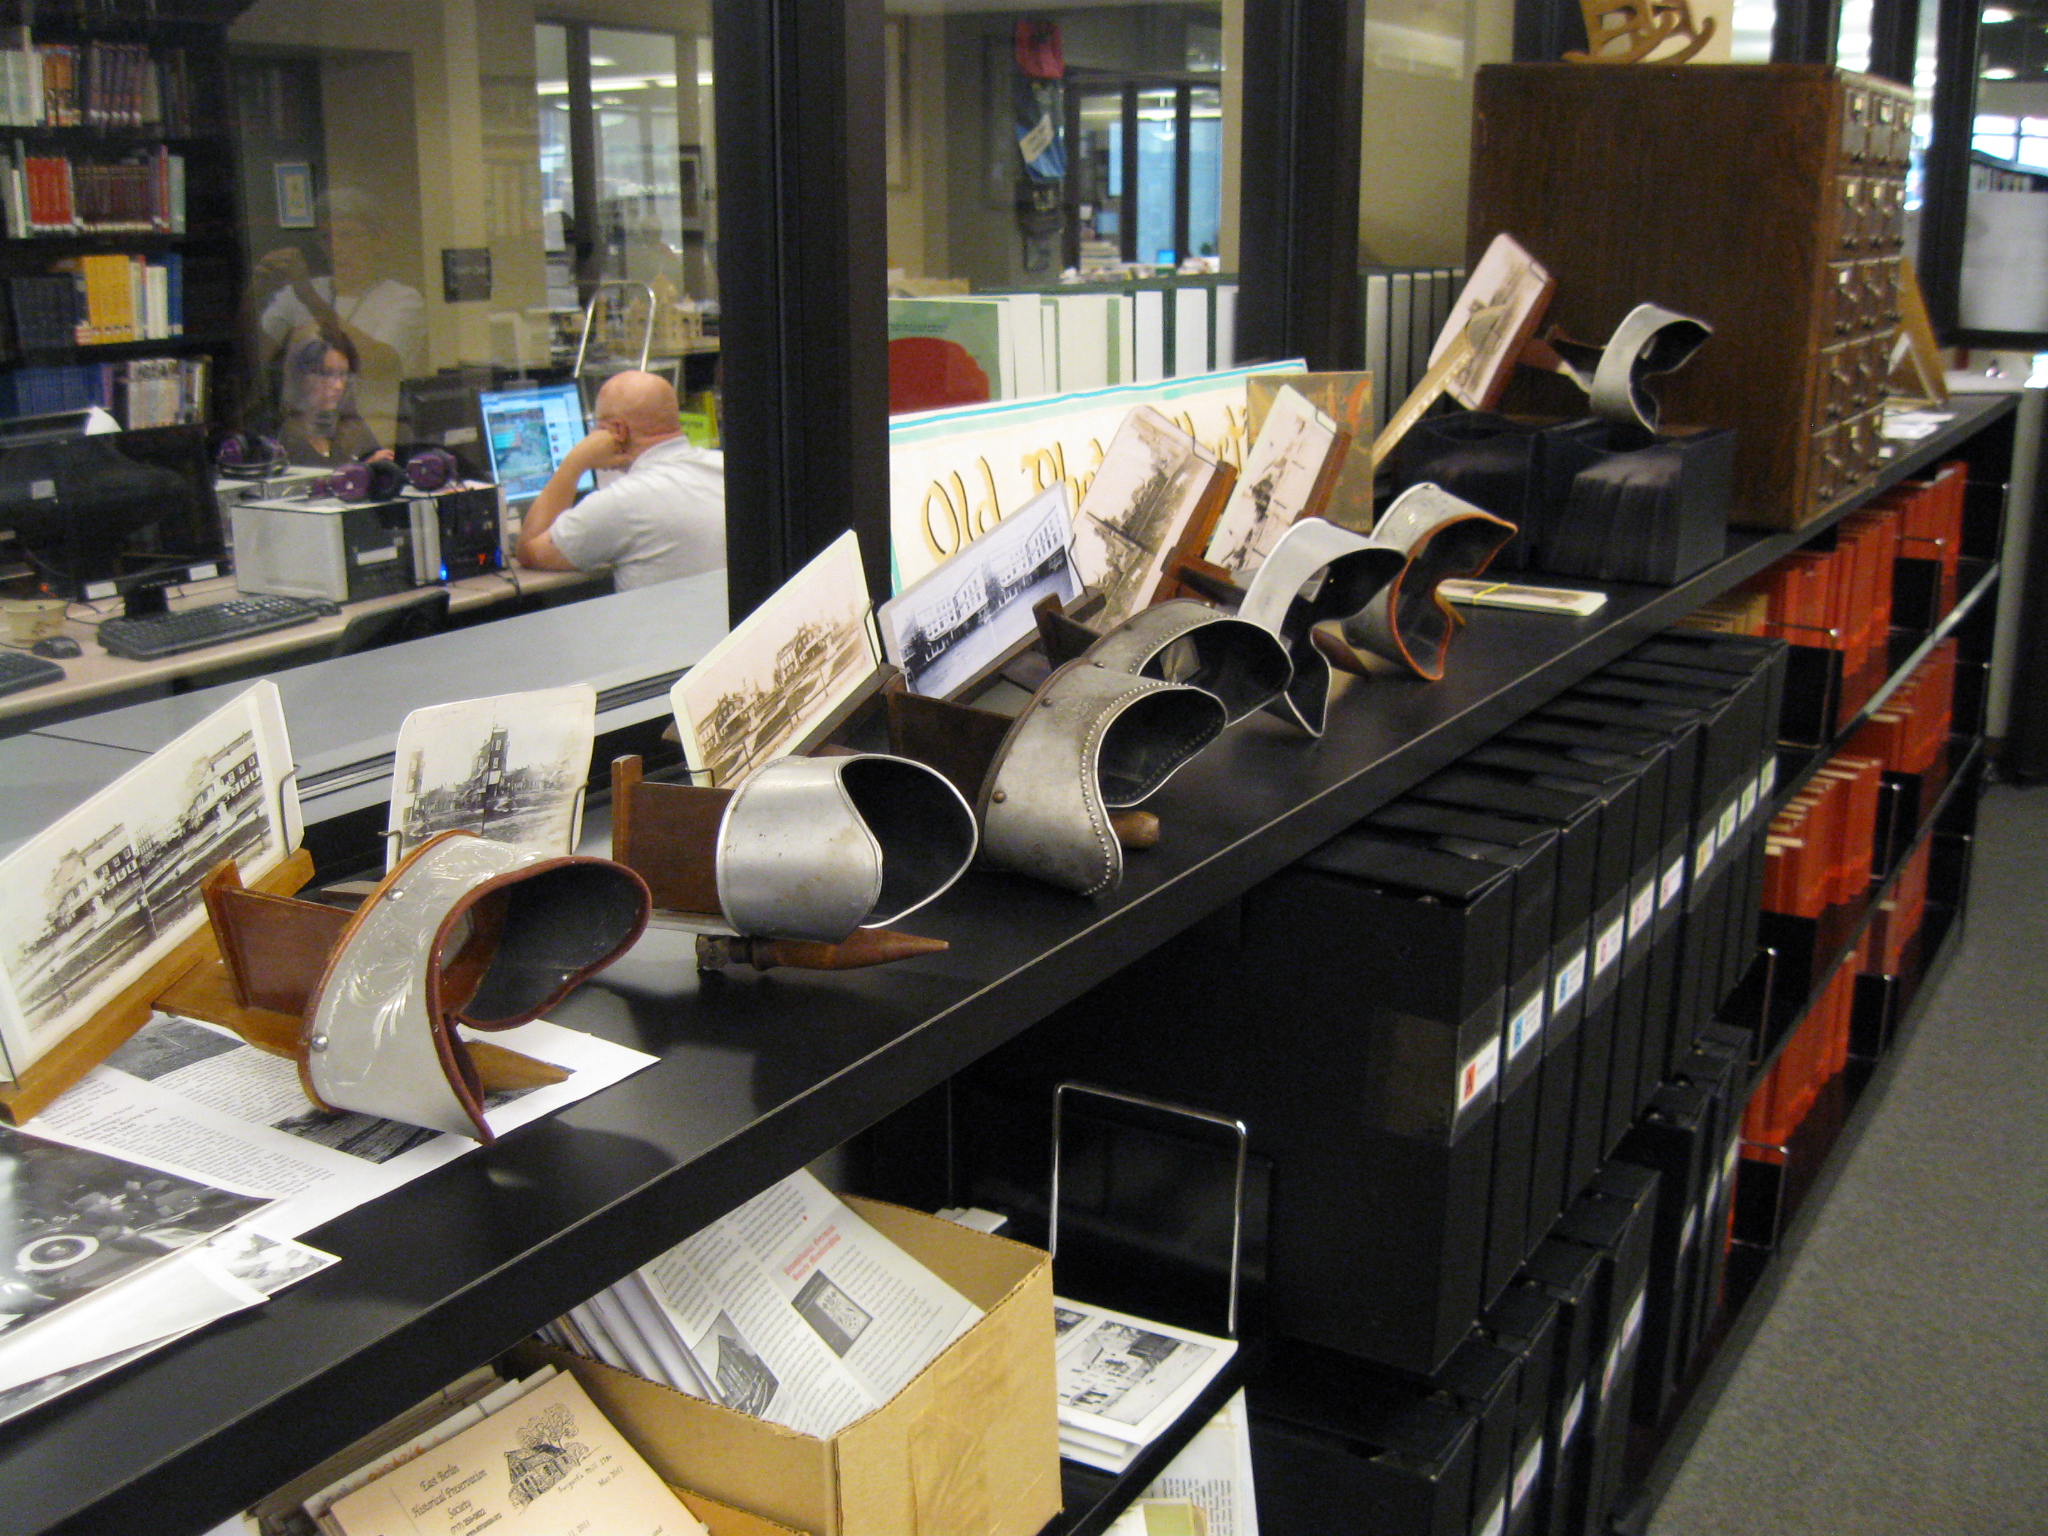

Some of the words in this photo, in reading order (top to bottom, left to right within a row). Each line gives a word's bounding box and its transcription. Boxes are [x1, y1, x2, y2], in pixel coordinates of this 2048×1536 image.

[921, 454, 1002, 564] Old
[419, 1475, 438, 1492] East
[437, 1464, 460, 1482] Berlin
[610, 1465, 624, 1479] 2011
[411, 1489, 446, 1518] Historical
[444, 1469, 487, 1498] Preservation
[447, 1500, 473, 1520] Society
